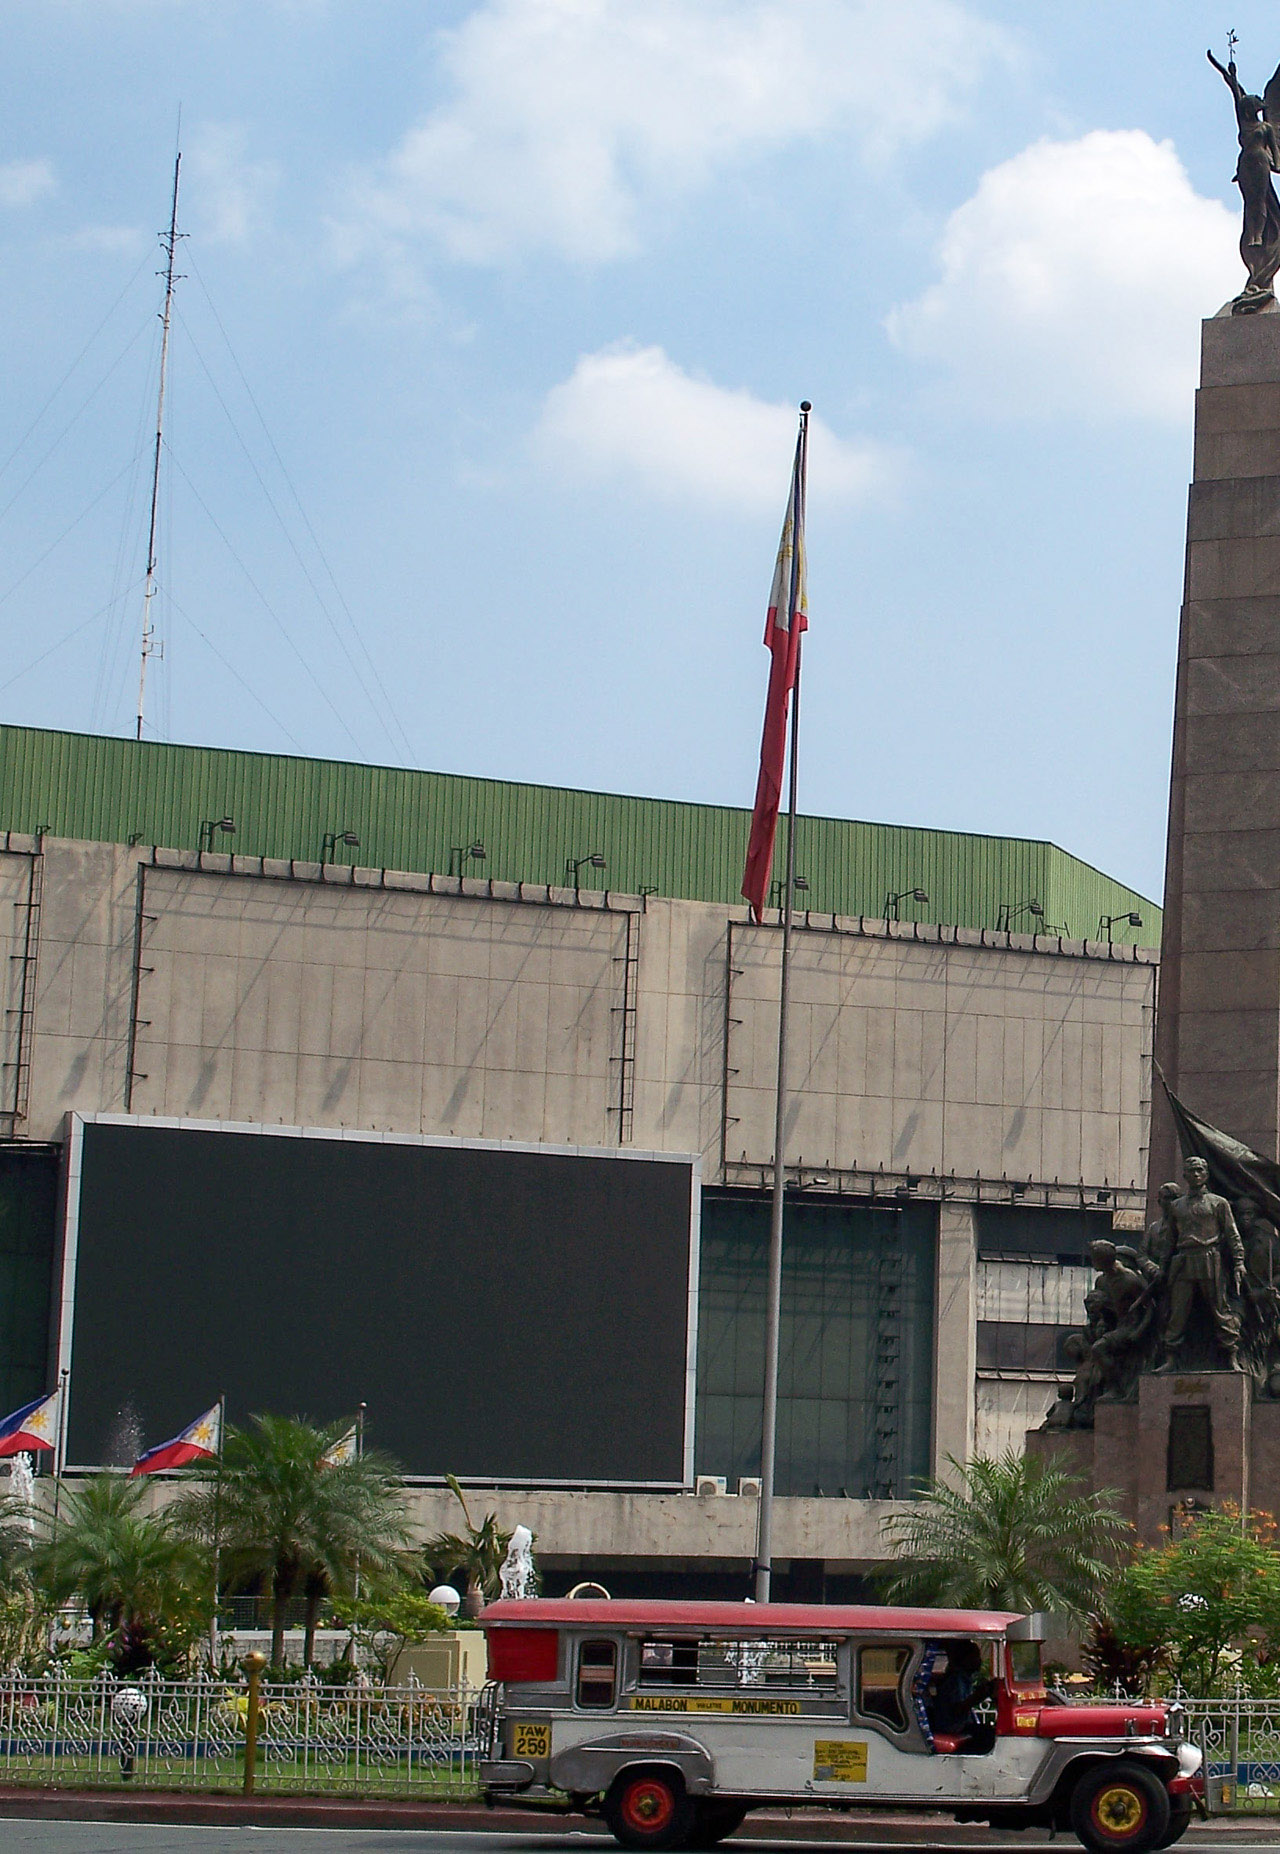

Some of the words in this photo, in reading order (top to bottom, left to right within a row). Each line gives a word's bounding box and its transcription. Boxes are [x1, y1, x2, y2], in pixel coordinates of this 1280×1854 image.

[635, 1698, 688, 1711] MALABON
[732, 1700, 798, 1714] MONUMENTO
[518, 1726, 547, 1737] TAW
[517, 1738, 546, 1755] 259
